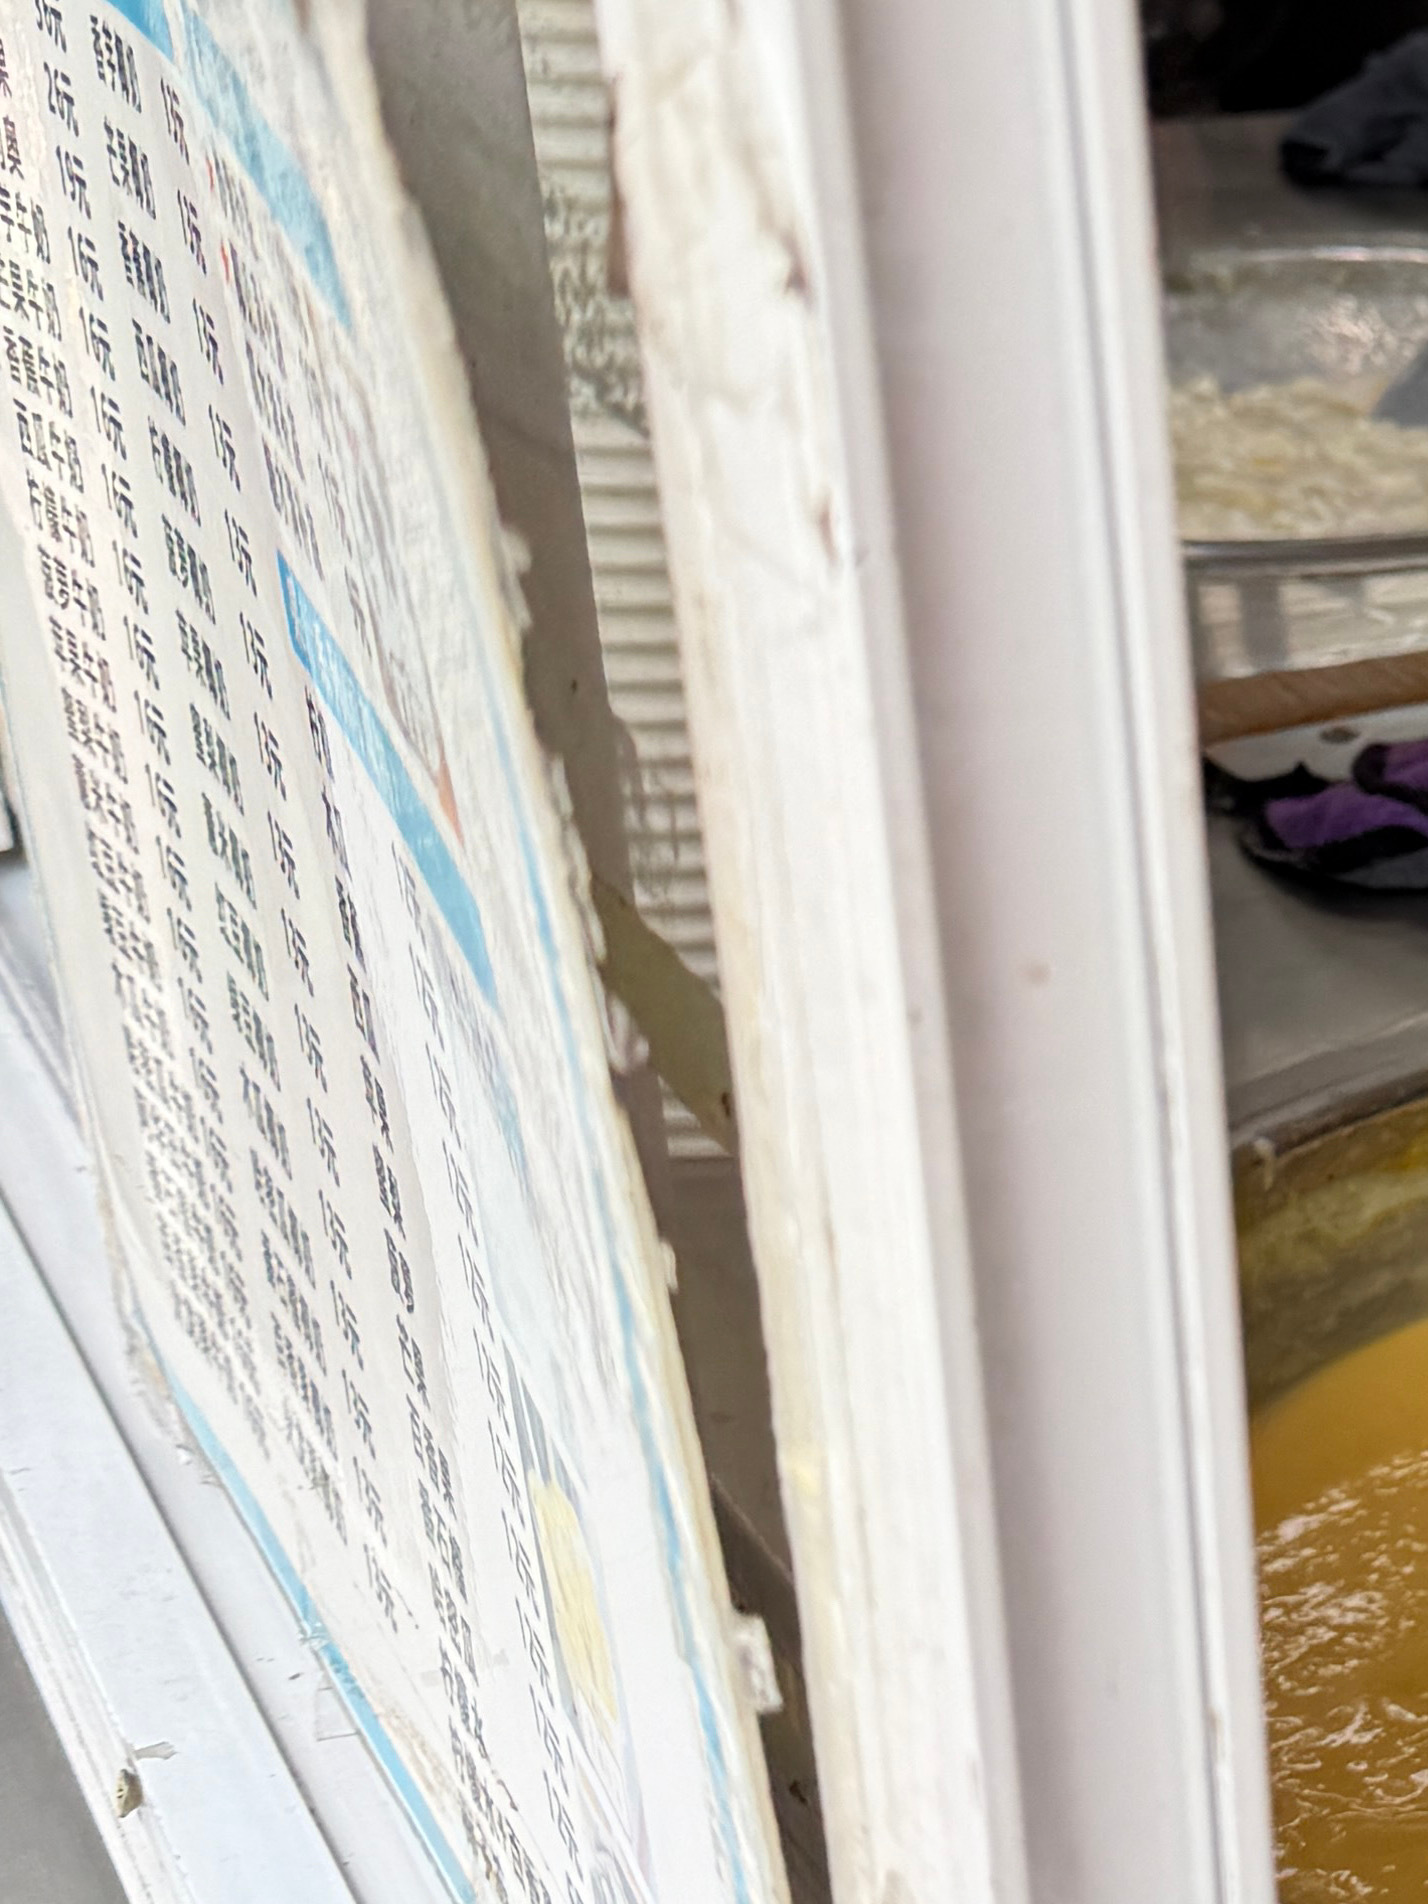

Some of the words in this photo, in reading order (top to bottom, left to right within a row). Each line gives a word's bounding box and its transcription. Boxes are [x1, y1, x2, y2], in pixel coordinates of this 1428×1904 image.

[44, 62, 79, 137] 26元
[160, 77, 189, 165] 13元
[56, 145, 91, 219] 19元
[68, 226, 103, 301] 16元
[177, 189, 207, 275] 13元
[79, 307, 115, 381] 16元
[193, 298, 224, 385] 13元
[90, 386, 127, 460] 16元
[209, 404, 240, 492] 13元
[101, 464, 138, 538] 16元
[112, 541, 148, 615] 16元
[225, 509, 257, 597] 13元
[124, 616, 160, 690] 16元
[240, 612, 272, 700] 13元
[134, 691, 171, 765] 16元
[254, 712, 286, 801] 13元
[145, 764, 181, 839] 16元
[156, 836, 192, 911] 16元
[267, 811, 300, 900] 13元
[391, 842, 427, 951] 12元
[167, 908, 202, 983] 16元
[281, 908, 314, 997] 13元
[177, 977, 213, 1055] 16元
[409, 942, 445, 1052] 12元
[189, 1047, 223, 1124] 16元
[294, 1003, 327, 1093] 13元
[425, 1042, 461, 1150] 12元
[306, 1097, 340, 1187] 13元
[318, 1189, 352, 1280] 13元
[442, 1139, 478, 1248] 12元
[330, 1280, 364, 1370] 13元
[458, 1234, 494, 1343] 12元
[342, 1369, 376, 1459] 13元
[473, 1327, 510, 1437] 12元
[488, 1418, 525, 1529] 12元
[501, 1509, 540, 1620] 12元
[515, 1597, 554, 1708] 12元
[529, 1684, 569, 1797] 12元
[543, 1770, 583, 1882] 12元
